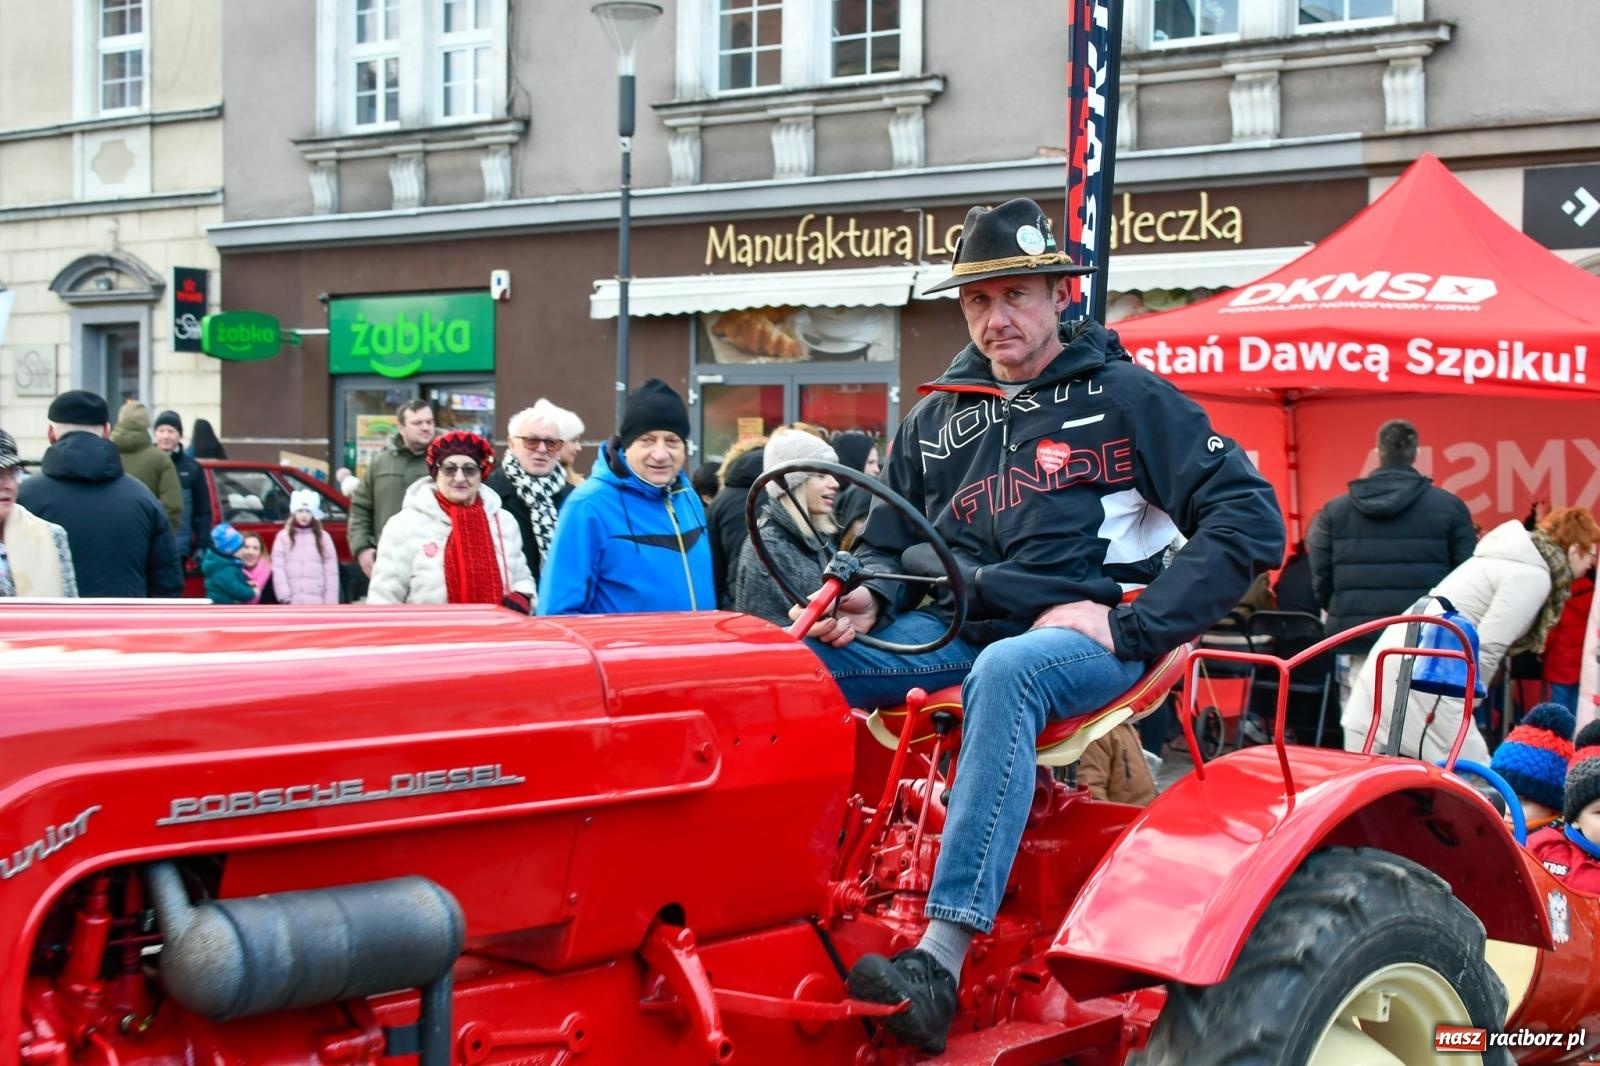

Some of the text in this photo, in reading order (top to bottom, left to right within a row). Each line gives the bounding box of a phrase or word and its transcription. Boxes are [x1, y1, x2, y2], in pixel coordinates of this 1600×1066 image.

[705, 213, 913, 267] Manufaktura
[1110, 191, 1243, 250] łeczka
[1228, 270, 1433, 307] DKMS
[217, 322, 275, 344] żabka
[350, 310, 471, 356] żabka
[1125, 334, 1588, 385] stań Dawcą Szpiku!
[163, 763, 523, 824] PORSCHE DIESEL
